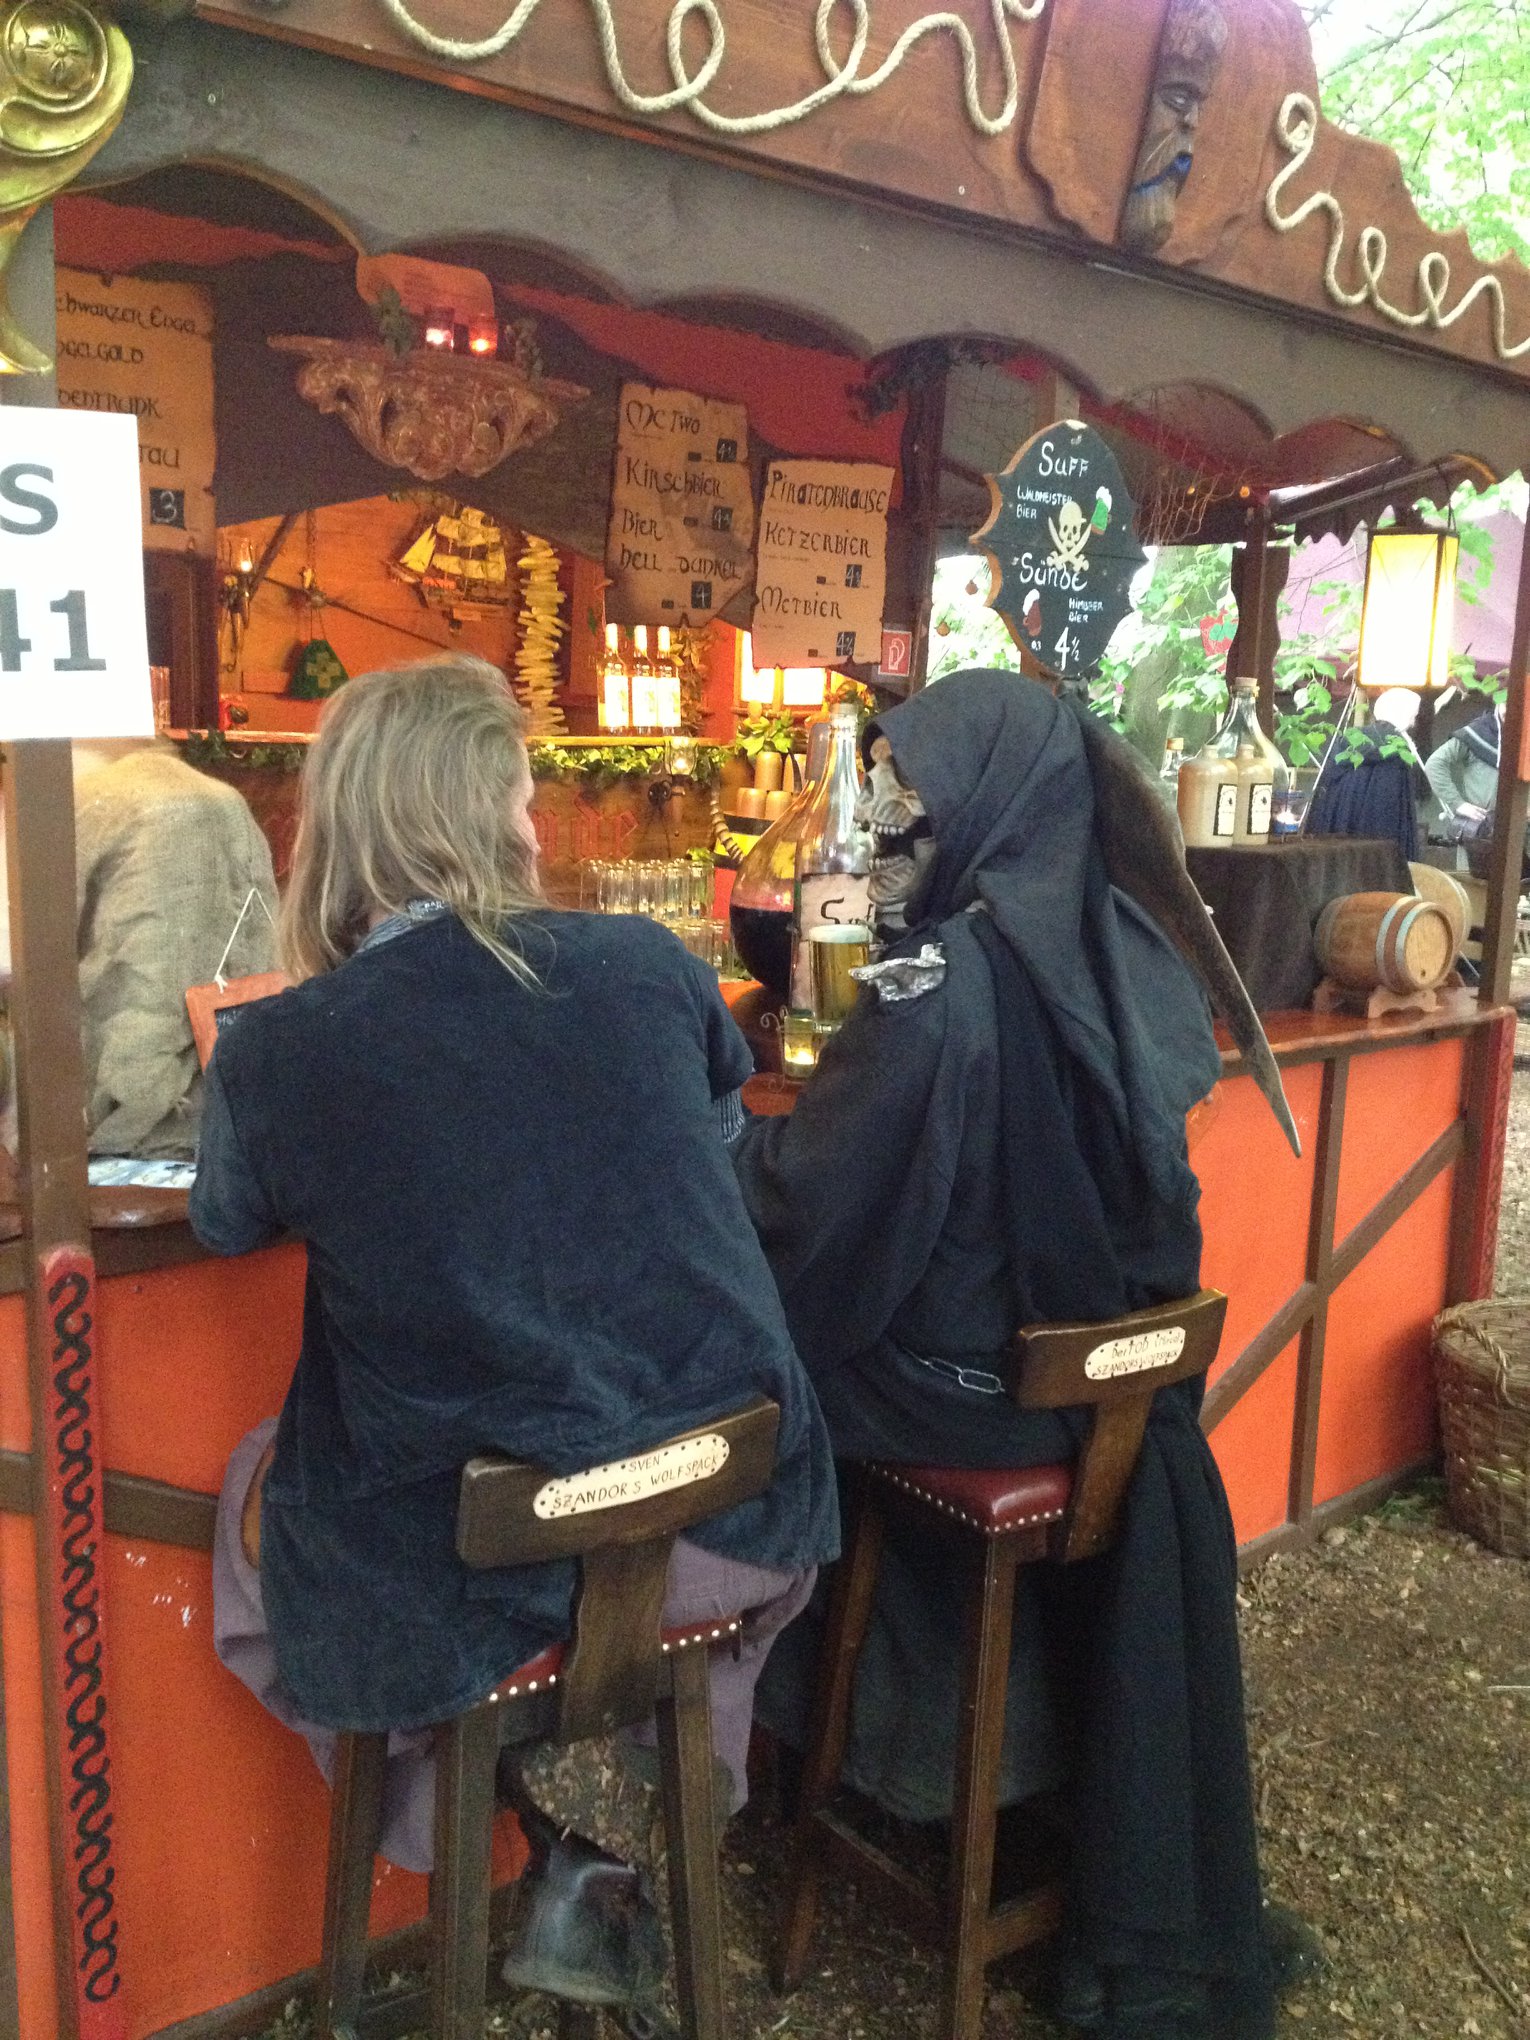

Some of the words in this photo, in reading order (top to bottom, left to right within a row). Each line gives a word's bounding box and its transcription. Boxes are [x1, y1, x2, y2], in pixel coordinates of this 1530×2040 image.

[0, 463, 59, 535] S
[152, 491, 178, 523] 3
[695, 584, 710, 610] 4
[628, 1455, 661, 1473] SVEN
[650, 1454, 719, 1487] WOLFSPACK
